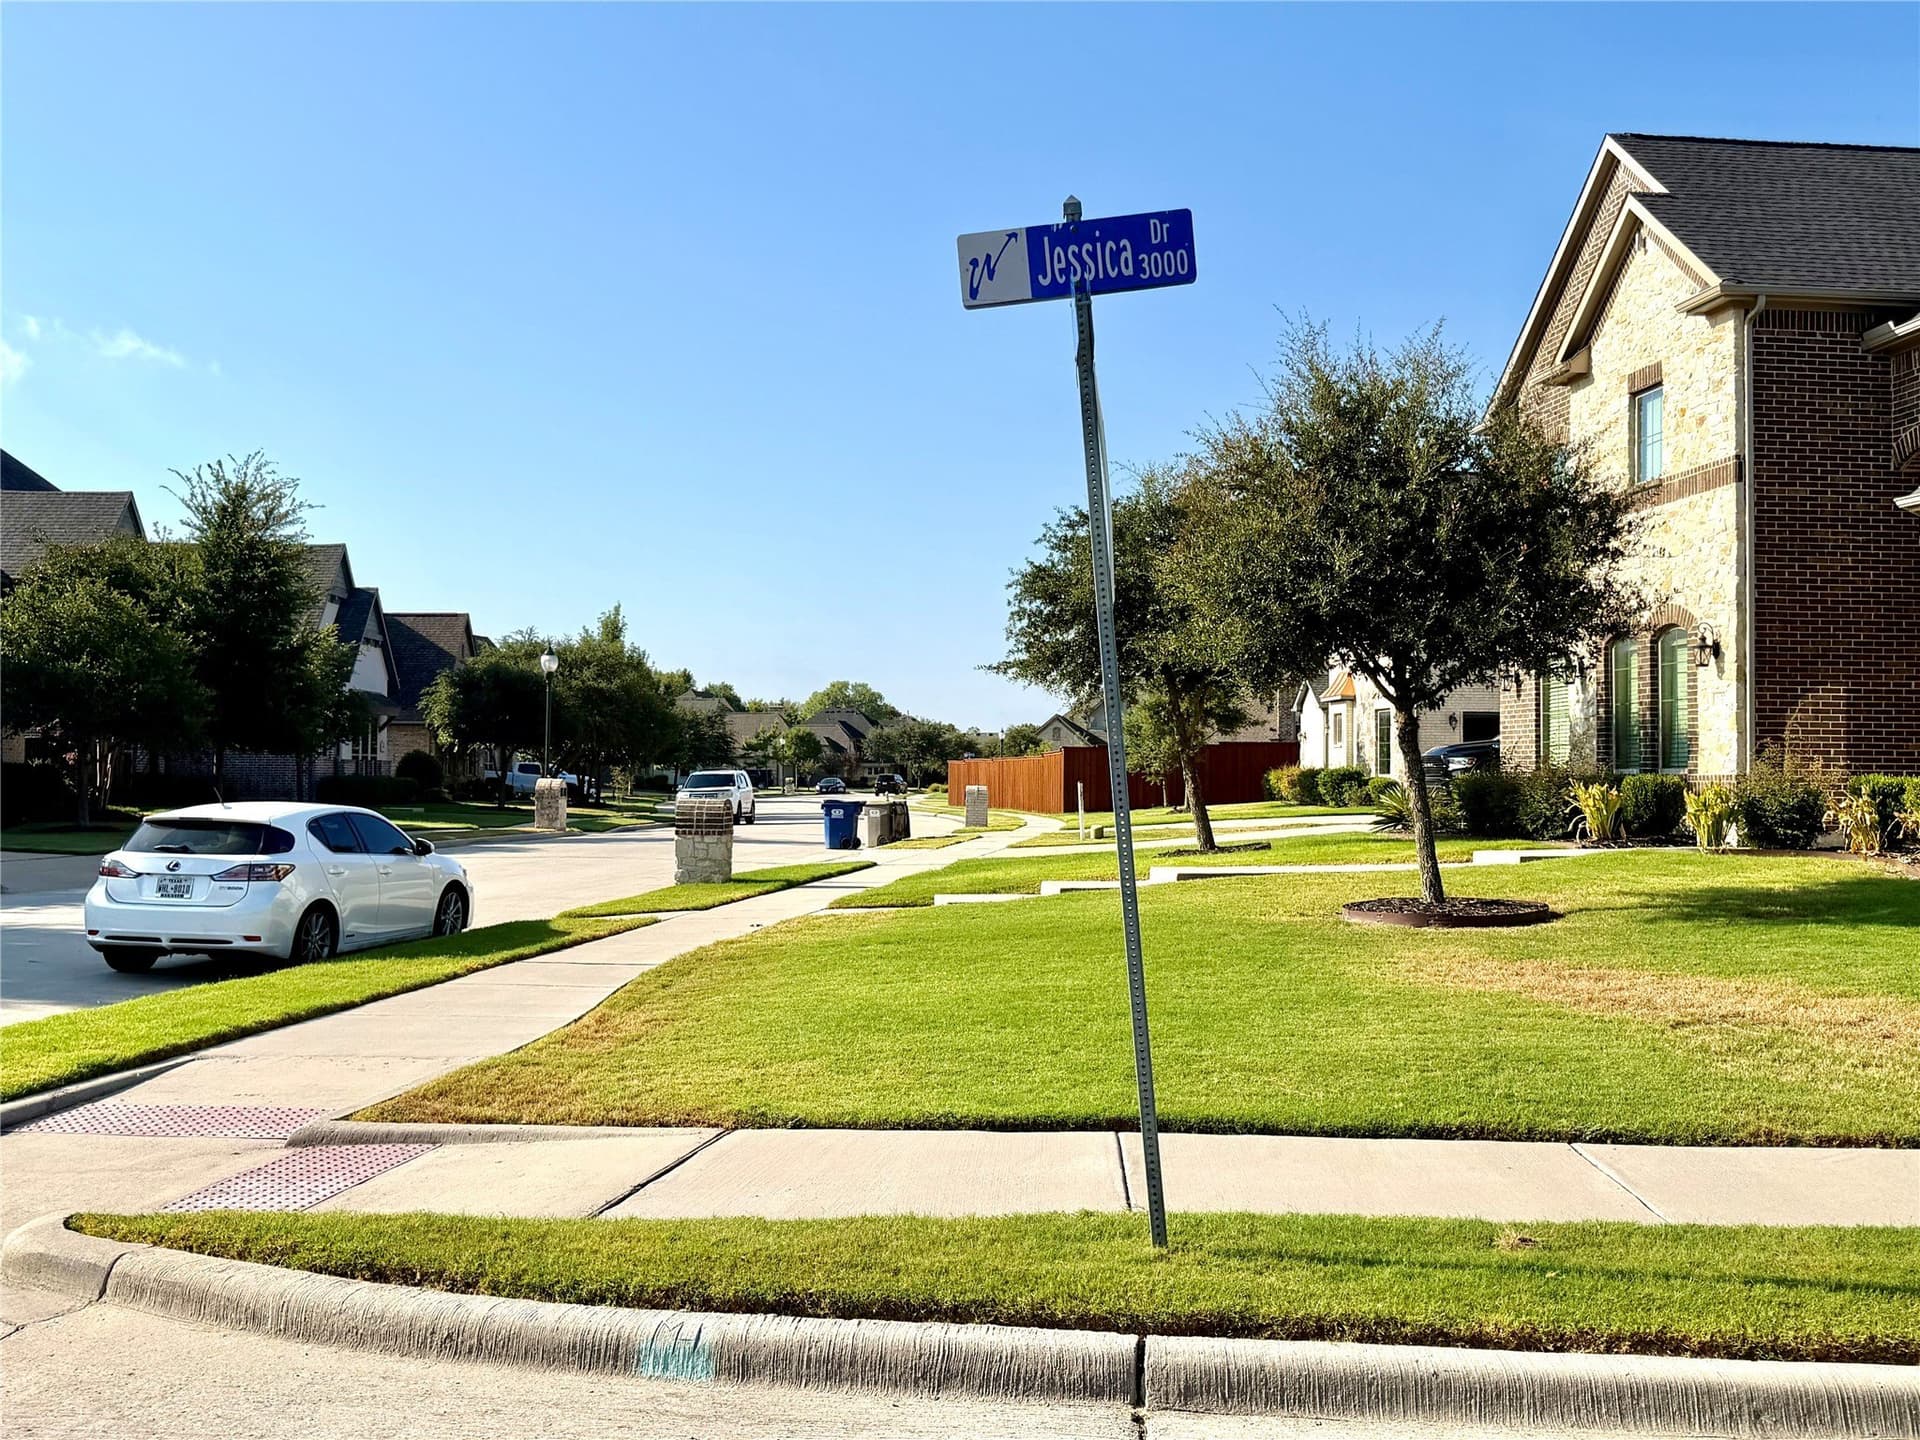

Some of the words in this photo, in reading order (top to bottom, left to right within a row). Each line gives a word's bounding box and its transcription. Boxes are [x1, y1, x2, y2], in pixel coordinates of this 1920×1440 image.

[1038, 230, 1134, 287] Jessica
[1150, 218, 1170, 245] Dr
[1138, 248, 1188, 280] 3000
